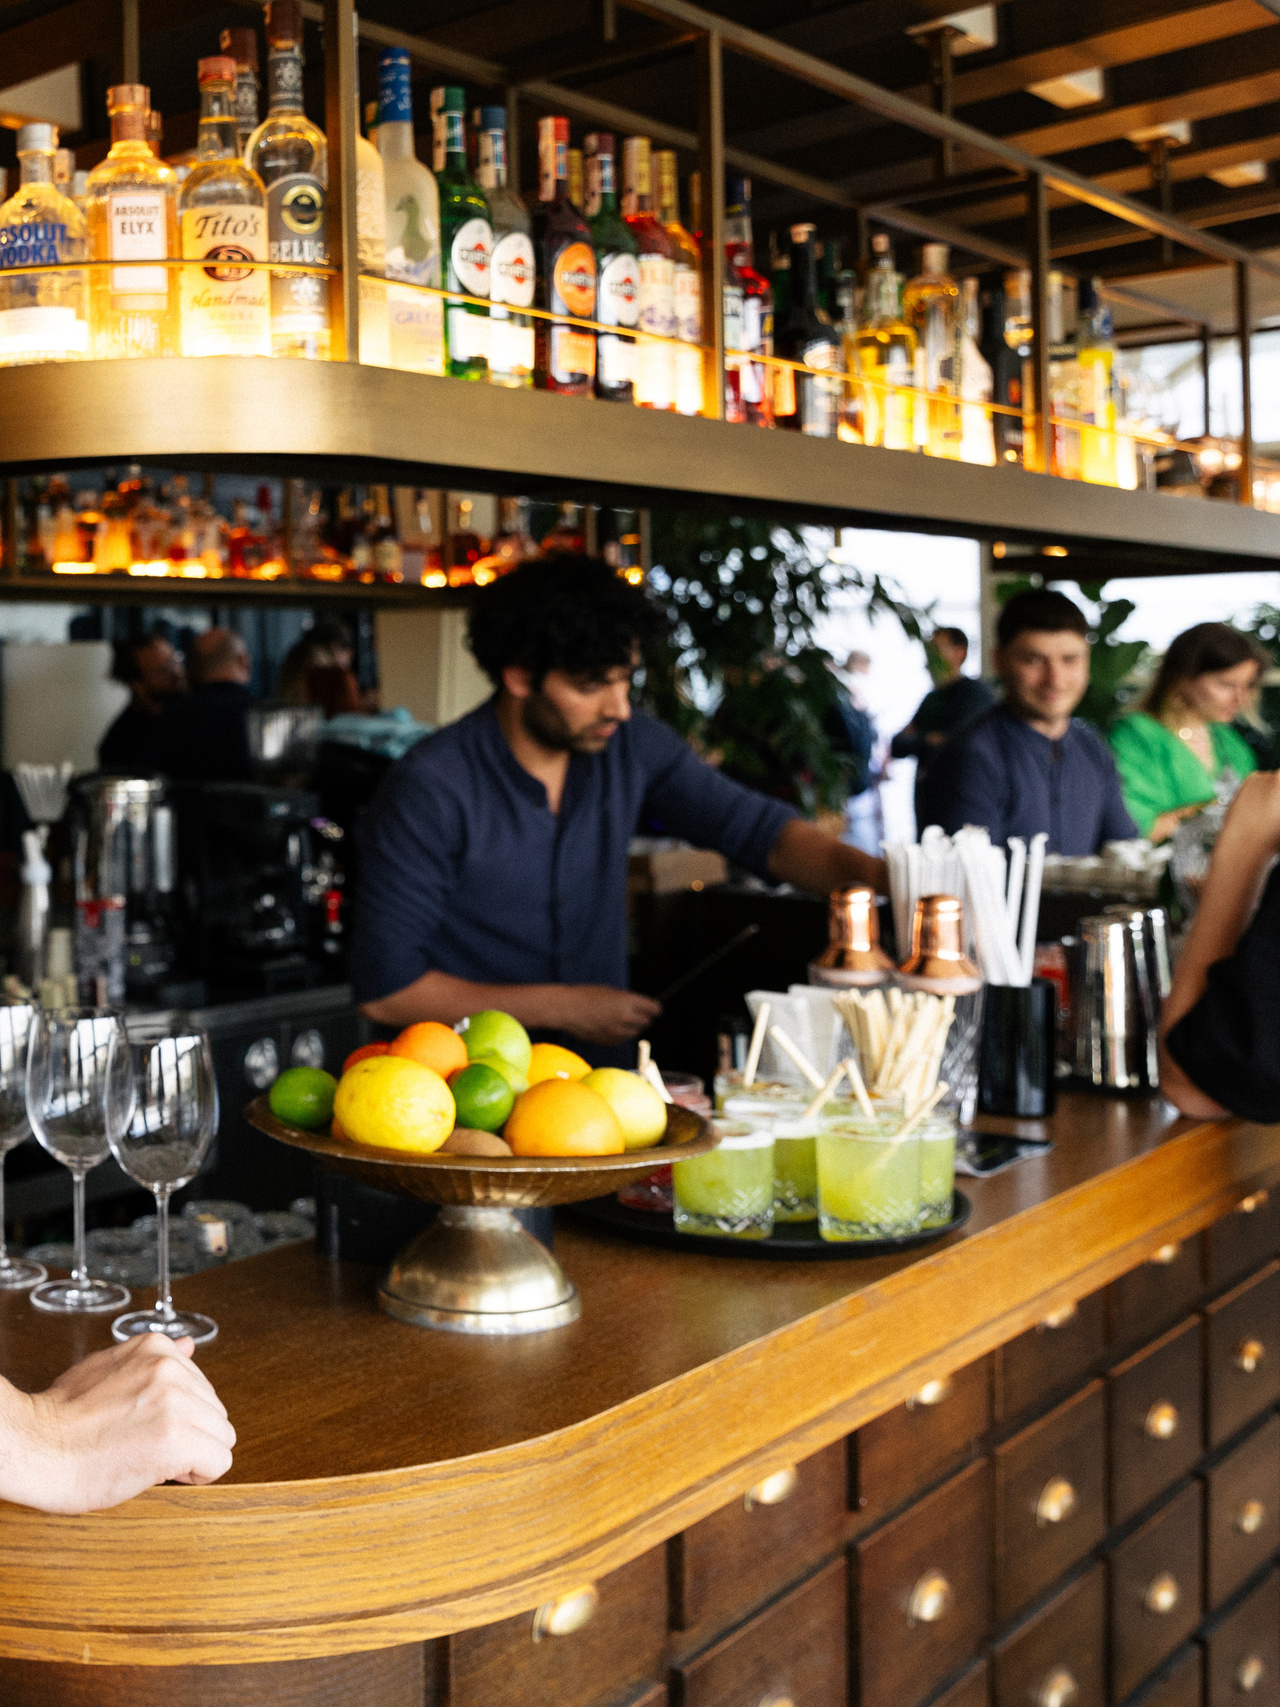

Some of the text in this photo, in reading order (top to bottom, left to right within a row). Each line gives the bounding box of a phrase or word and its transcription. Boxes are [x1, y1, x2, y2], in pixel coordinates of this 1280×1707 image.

[121, 221, 155, 235] ELYX
[195, 211, 261, 239] Tito's
[270, 239, 330, 263] BELUG
